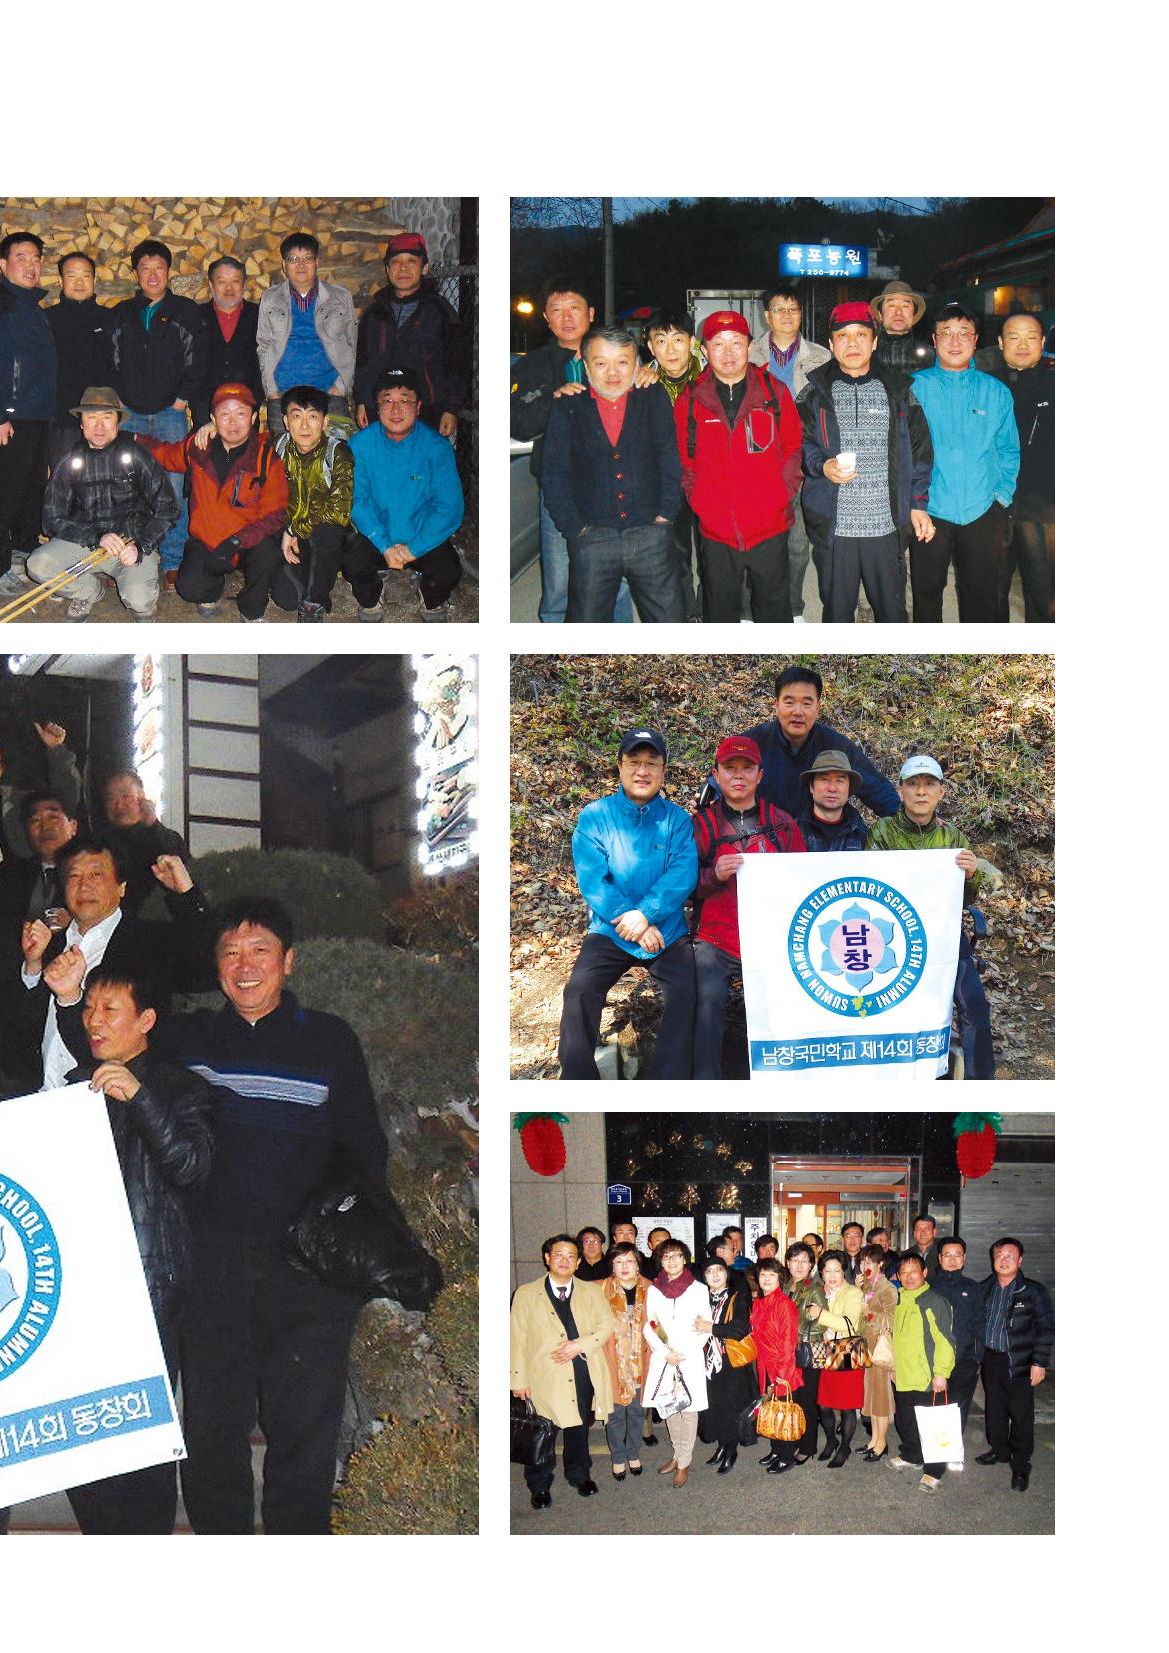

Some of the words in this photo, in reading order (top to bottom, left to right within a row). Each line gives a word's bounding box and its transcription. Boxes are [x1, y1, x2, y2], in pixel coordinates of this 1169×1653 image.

[787, 247, 861, 266] 폭포농원
[808, 881, 884, 911] ELEMENTARY
[792, 908, 814, 981] NAMCHANG
[841, 924, 872, 971] 남창
[908, 938, 923, 969] 14TH
[807, 978, 849, 1011] SUWON
[875, 969, 916, 1009] ALUMNI
[762, 1041, 857, 1066] 남창국민학교
[860, 1039, 913, 1060] 제14회
[616, 1195, 622, 1203] 3
[32, 1243, 55, 1295] 14TH
[71, 1388, 153, 1436] 동창회
